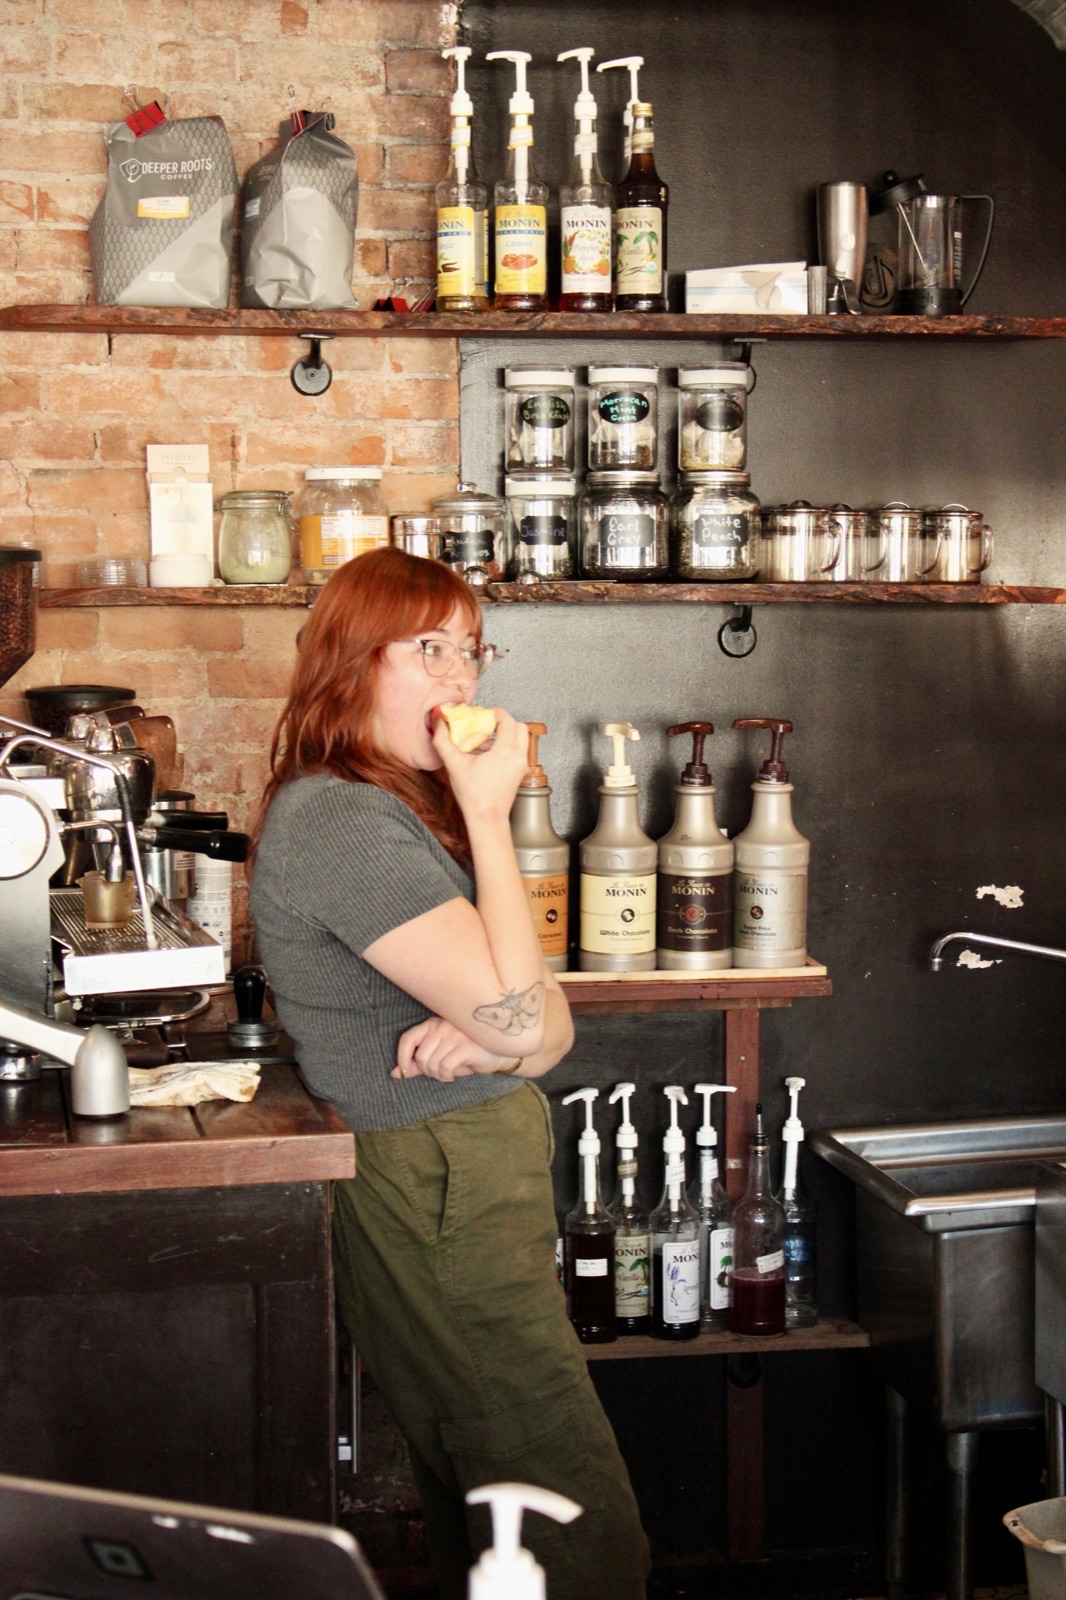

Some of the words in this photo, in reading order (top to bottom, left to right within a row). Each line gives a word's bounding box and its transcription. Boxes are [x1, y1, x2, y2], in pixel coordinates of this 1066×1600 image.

[142, 162, 178, 174] DEEPER
[181, 158, 212, 173] ROOTS
[499, 219, 541, 228] MONIN
[566, 219, 608, 229] MONIN
[609, 404, 637, 415] Mint
[161, 453, 196, 461] RISHI
[608, 516, 639, 532] Earl
[701, 516, 742, 529] White
[521, 525, 565, 538] Jasmine
[701, 527, 742, 542] Peach
[607, 532, 641, 546] Grey
[531, 888, 567, 899] MONIN
[605, 888, 648, 897] MONIN
[671, 885, 716, 896] MONIN
[739, 885, 779, 896] MONIN
[621, 929, 651, 937] Chocolate
[615, 1247, 647, 1257] ONIN
[672, 1253, 699, 1264] MON
